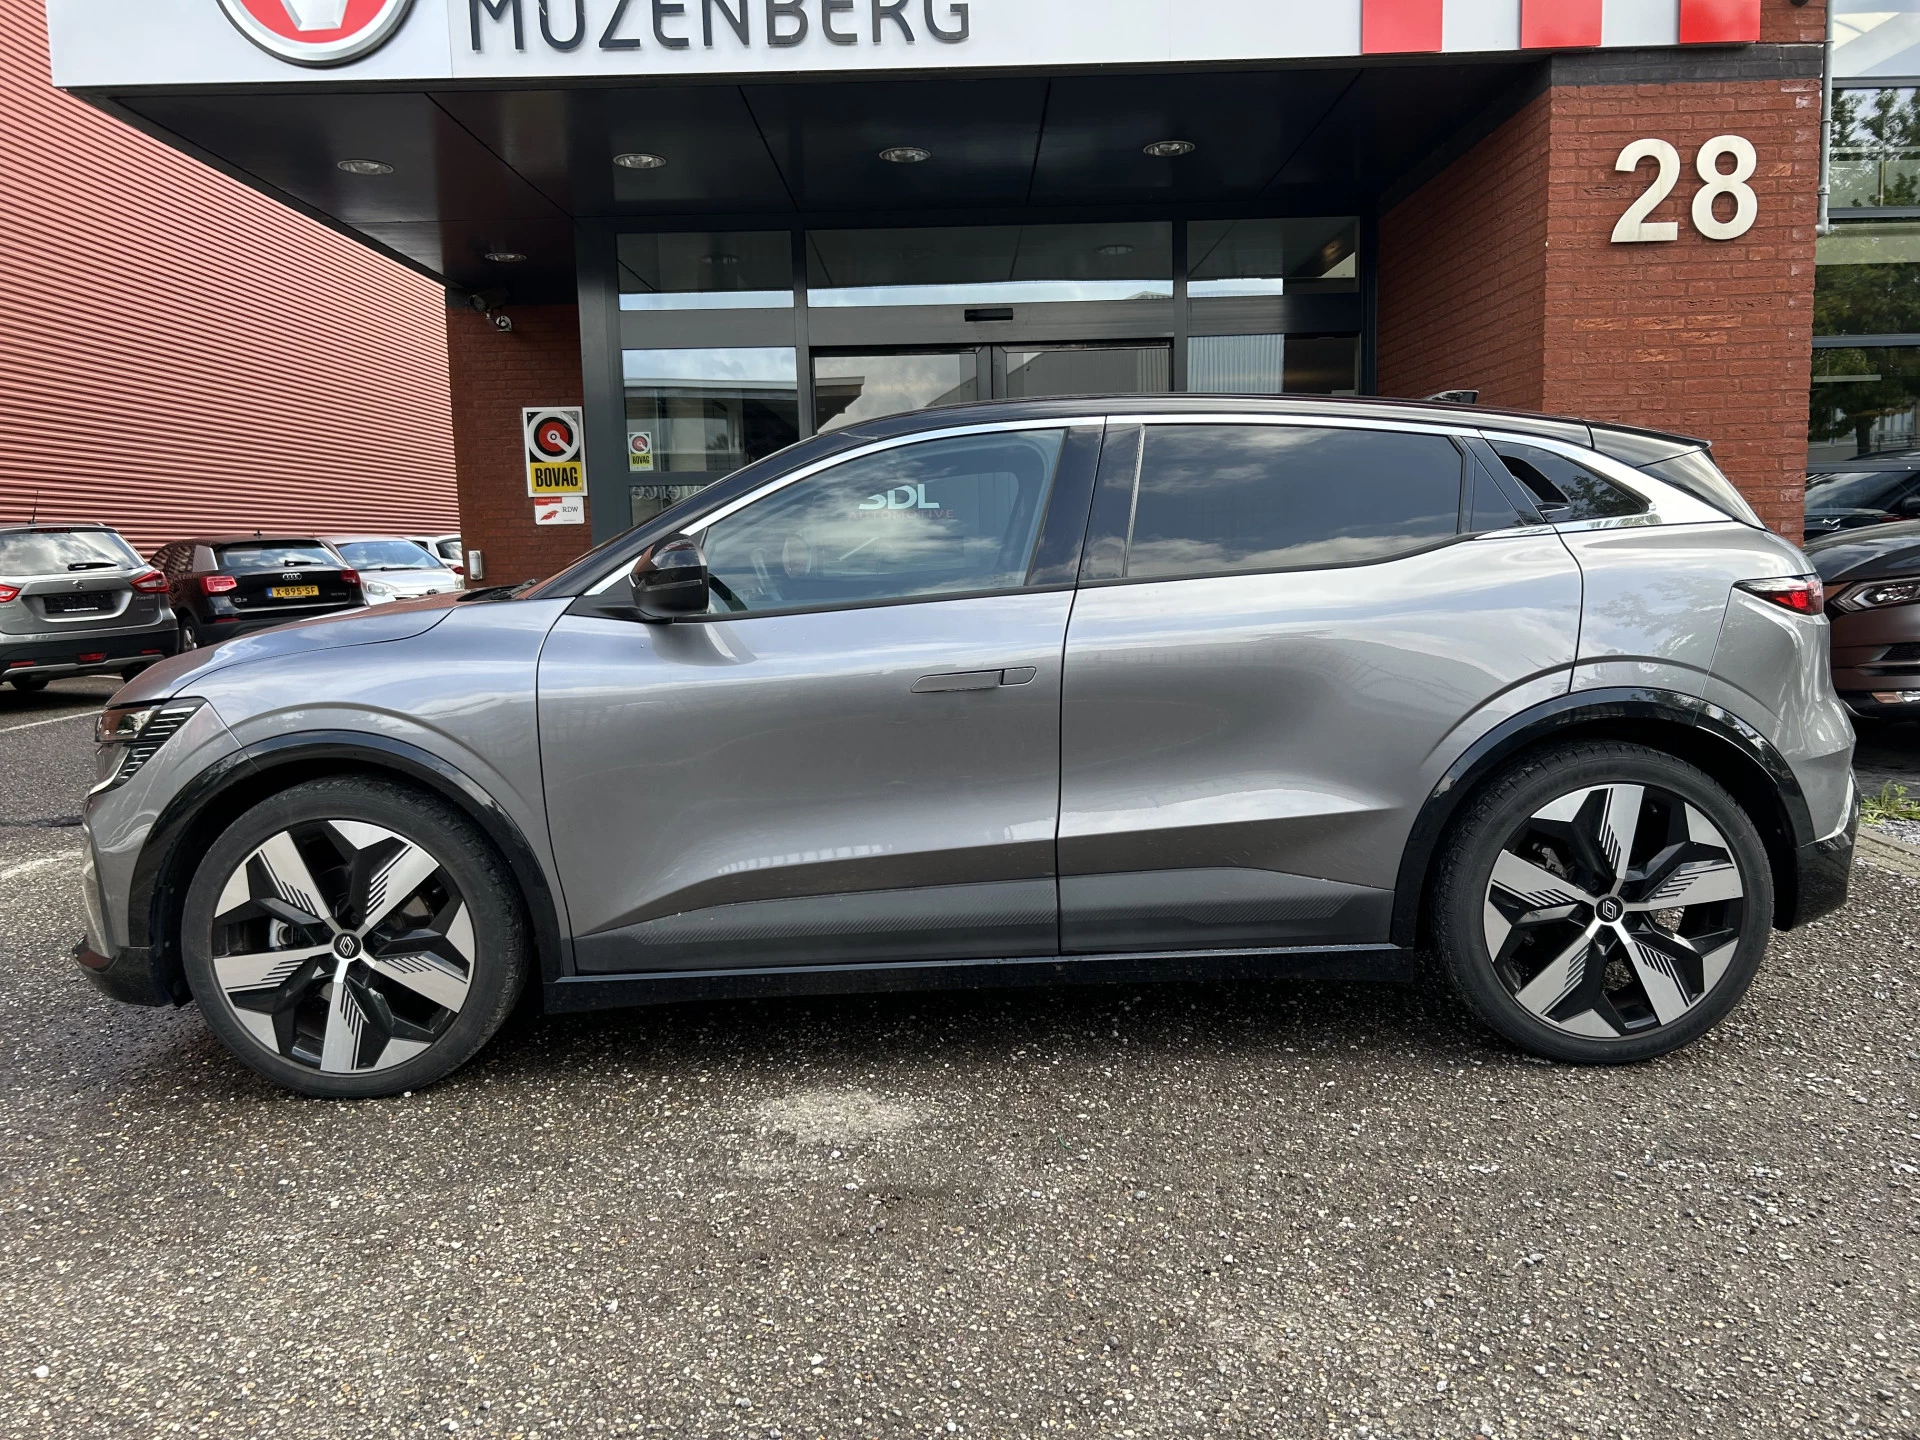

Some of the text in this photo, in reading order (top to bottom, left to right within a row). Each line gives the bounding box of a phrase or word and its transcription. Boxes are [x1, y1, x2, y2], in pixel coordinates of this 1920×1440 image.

[471, 0, 970, 51] MUZENBERG
[1611, 134, 1758, 242] 28
[632, 455, 650, 465] BOVAG
[535, 467, 578, 488] BOVAG
[858, 483, 940, 510] SDL
[848, 509, 955, 521] AUTOMOTIVE
[275, 586, 316, 597] X-895-SF
